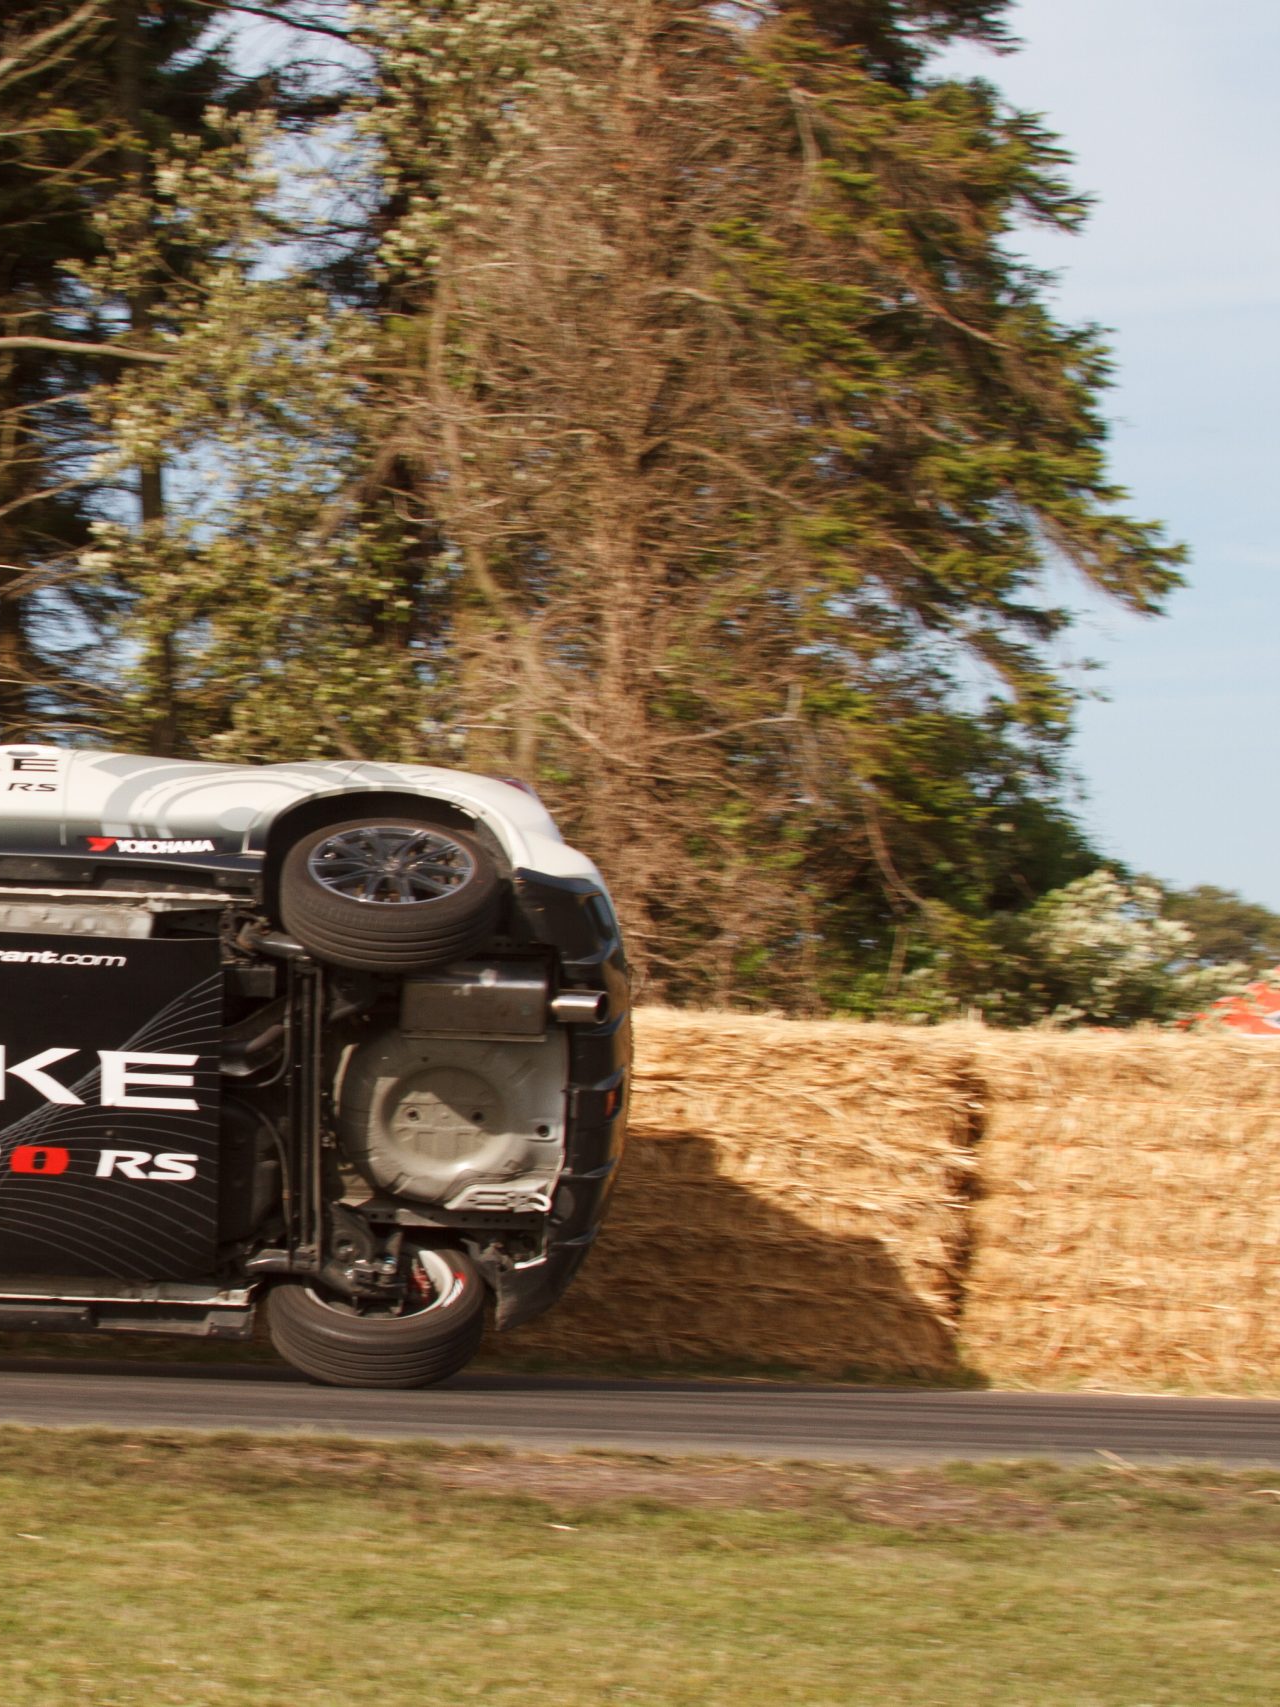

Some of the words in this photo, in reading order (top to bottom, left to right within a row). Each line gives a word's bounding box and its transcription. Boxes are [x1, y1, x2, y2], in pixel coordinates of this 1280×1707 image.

[7, 782, 58, 792] RS
[115, 839, 216, 854] YOKOHAMA
[95, 1149, 199, 1181] RS
